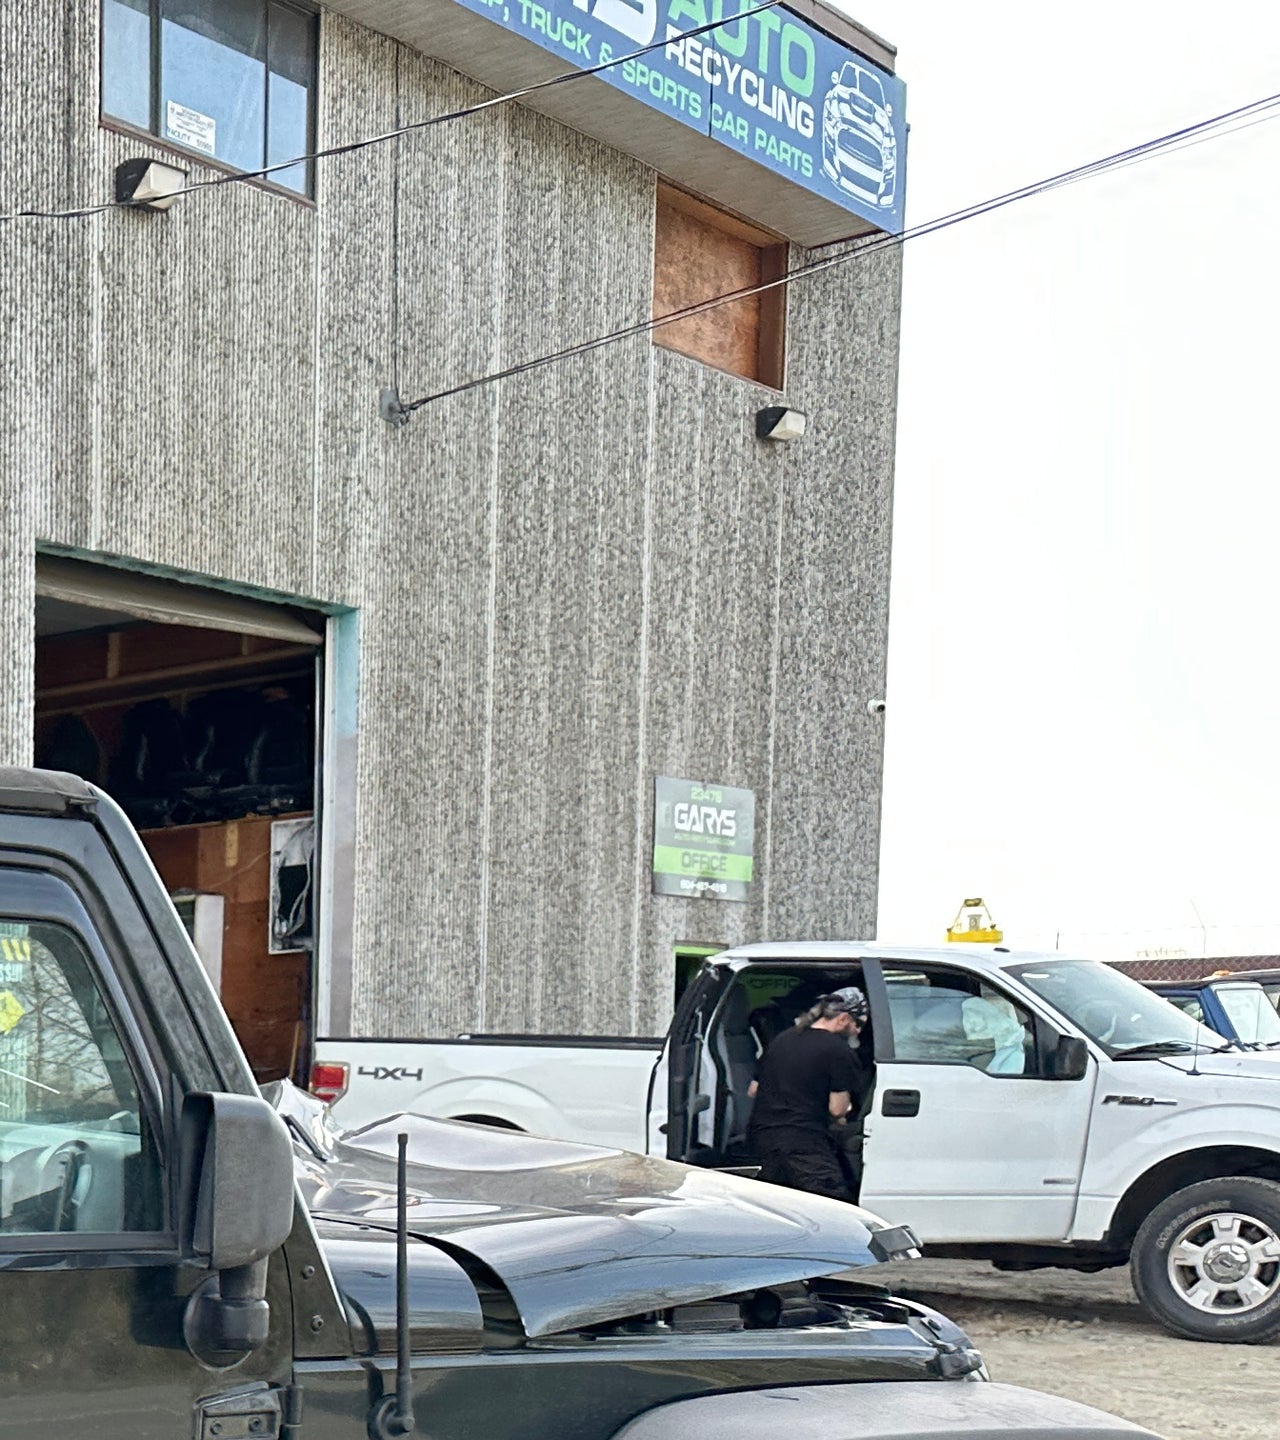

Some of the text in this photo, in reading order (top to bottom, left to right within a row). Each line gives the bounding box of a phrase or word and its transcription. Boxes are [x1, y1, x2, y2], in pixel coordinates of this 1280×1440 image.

[518, 0, 592, 60] TRUCK
[622, 58, 702, 119] SPORTS
[711, 102, 748, 144] CAR
[755, 127, 813, 178] PARTS
[665, 24, 814, 138] RECYCLING
[674, 802, 736, 837] GARYS
[681, 850, 727, 872] OFFICE
